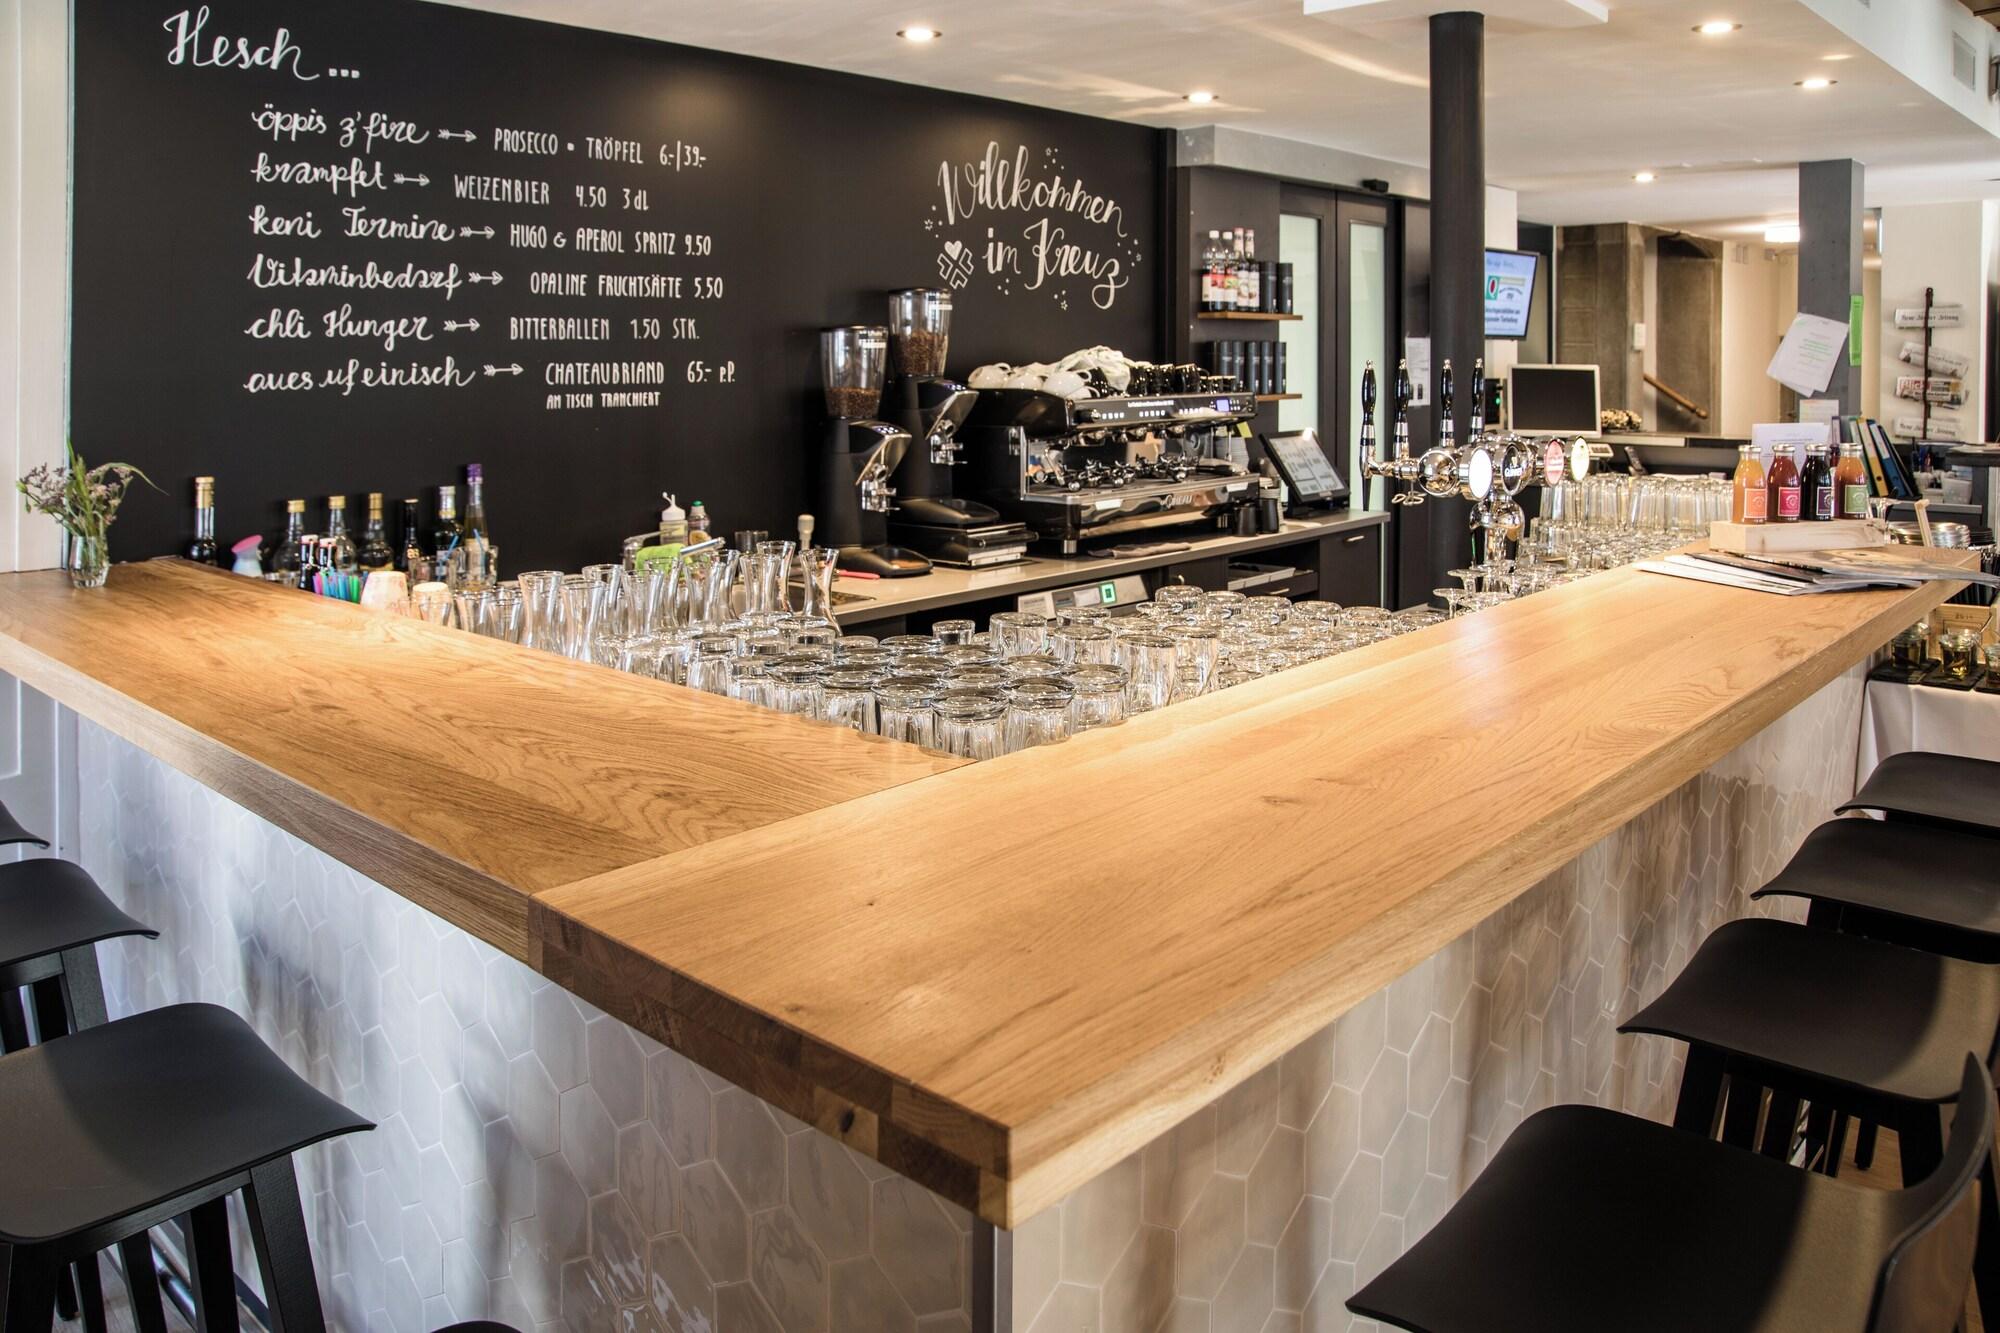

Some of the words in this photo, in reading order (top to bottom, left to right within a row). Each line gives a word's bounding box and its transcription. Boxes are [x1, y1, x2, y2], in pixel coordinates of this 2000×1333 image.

[163, 5, 320, 80] Hesch
[251, 104, 327, 141] öppis
[494, 128, 558, 155] PROSECCO
[586, 137, 644, 164] TRÖPFEL
[251, 152, 388, 197] krampfet
[454, 174, 550, 205] WEIZENBIER
[576, 185, 607, 208] 4.50
[937, 141, 1128, 238] Willkommen
[249, 205, 322, 239] keni
[342, 206, 456, 241] Termine
[511, 224, 547, 248] HUGO
[553, 232, 567, 248] &
[576, 228, 625, 252] APEROL
[634, 232, 676, 255] SPRITZ
[685, 235, 712, 256] 9.50
[247, 253, 463, 301] Vitaminbedarf
[530, 272, 588, 296] OPALINE
[599, 274, 683, 299] FRUCHTSÄFTE
[694, 276, 724, 299] 5.50
[982, 227, 1022, 274] im
[1024, 218, 1129, 310] Kreuz
[244, 308, 312, 339] chli
[322, 304, 434, 351] Hunger
[510, 317, 610, 341] BITTERBALLEN
[630, 318, 661, 340] 1.50
[672, 318, 700, 340] STK.
[243, 371, 314, 393] aues
[546, 362, 664, 385] CHATEAUBRIAND
[687, 360, 712, 383] 65.-
[546, 394, 561, 409] AM
[566, 394, 593, 408] TISCH
[601, 392, 660, 407] TRANCHIERT
